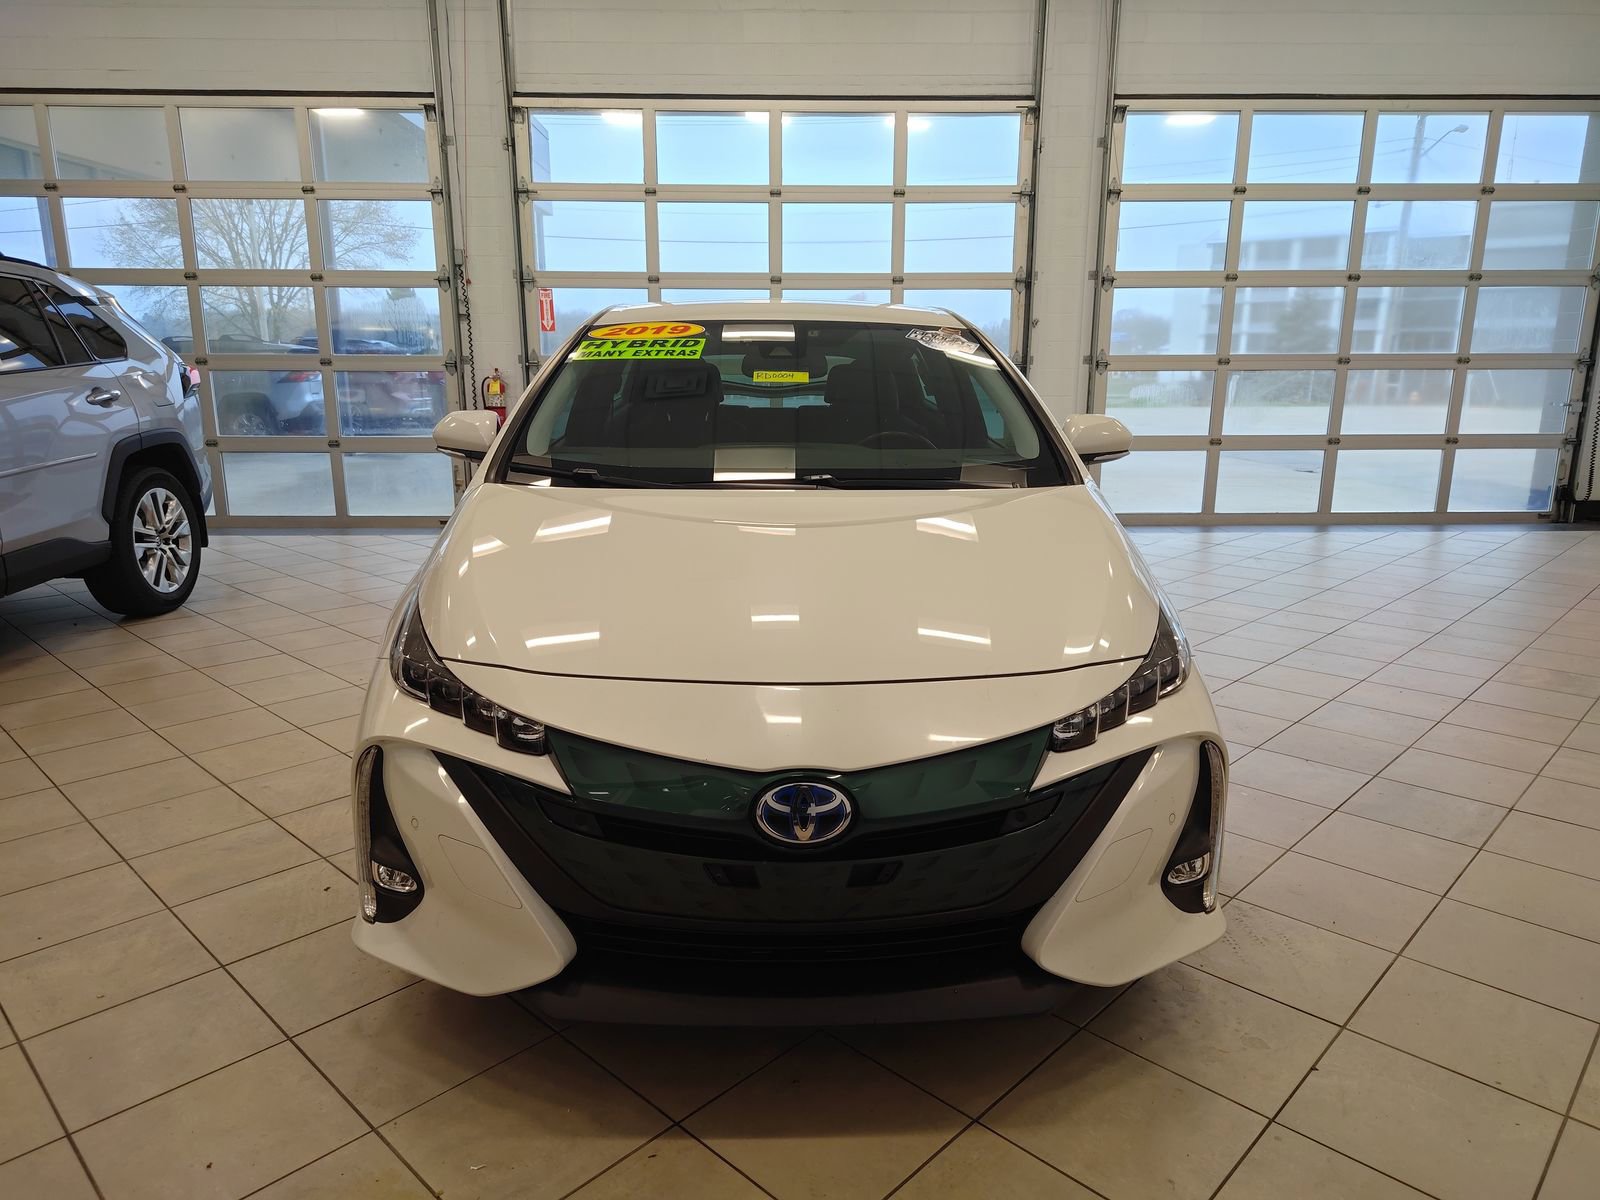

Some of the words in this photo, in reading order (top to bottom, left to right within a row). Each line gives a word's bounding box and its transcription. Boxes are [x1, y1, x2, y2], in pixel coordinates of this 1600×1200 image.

[603, 326, 689, 336] 2019
[583, 340, 700, 349] HYBRID
[580, 350, 626, 358] MANY
